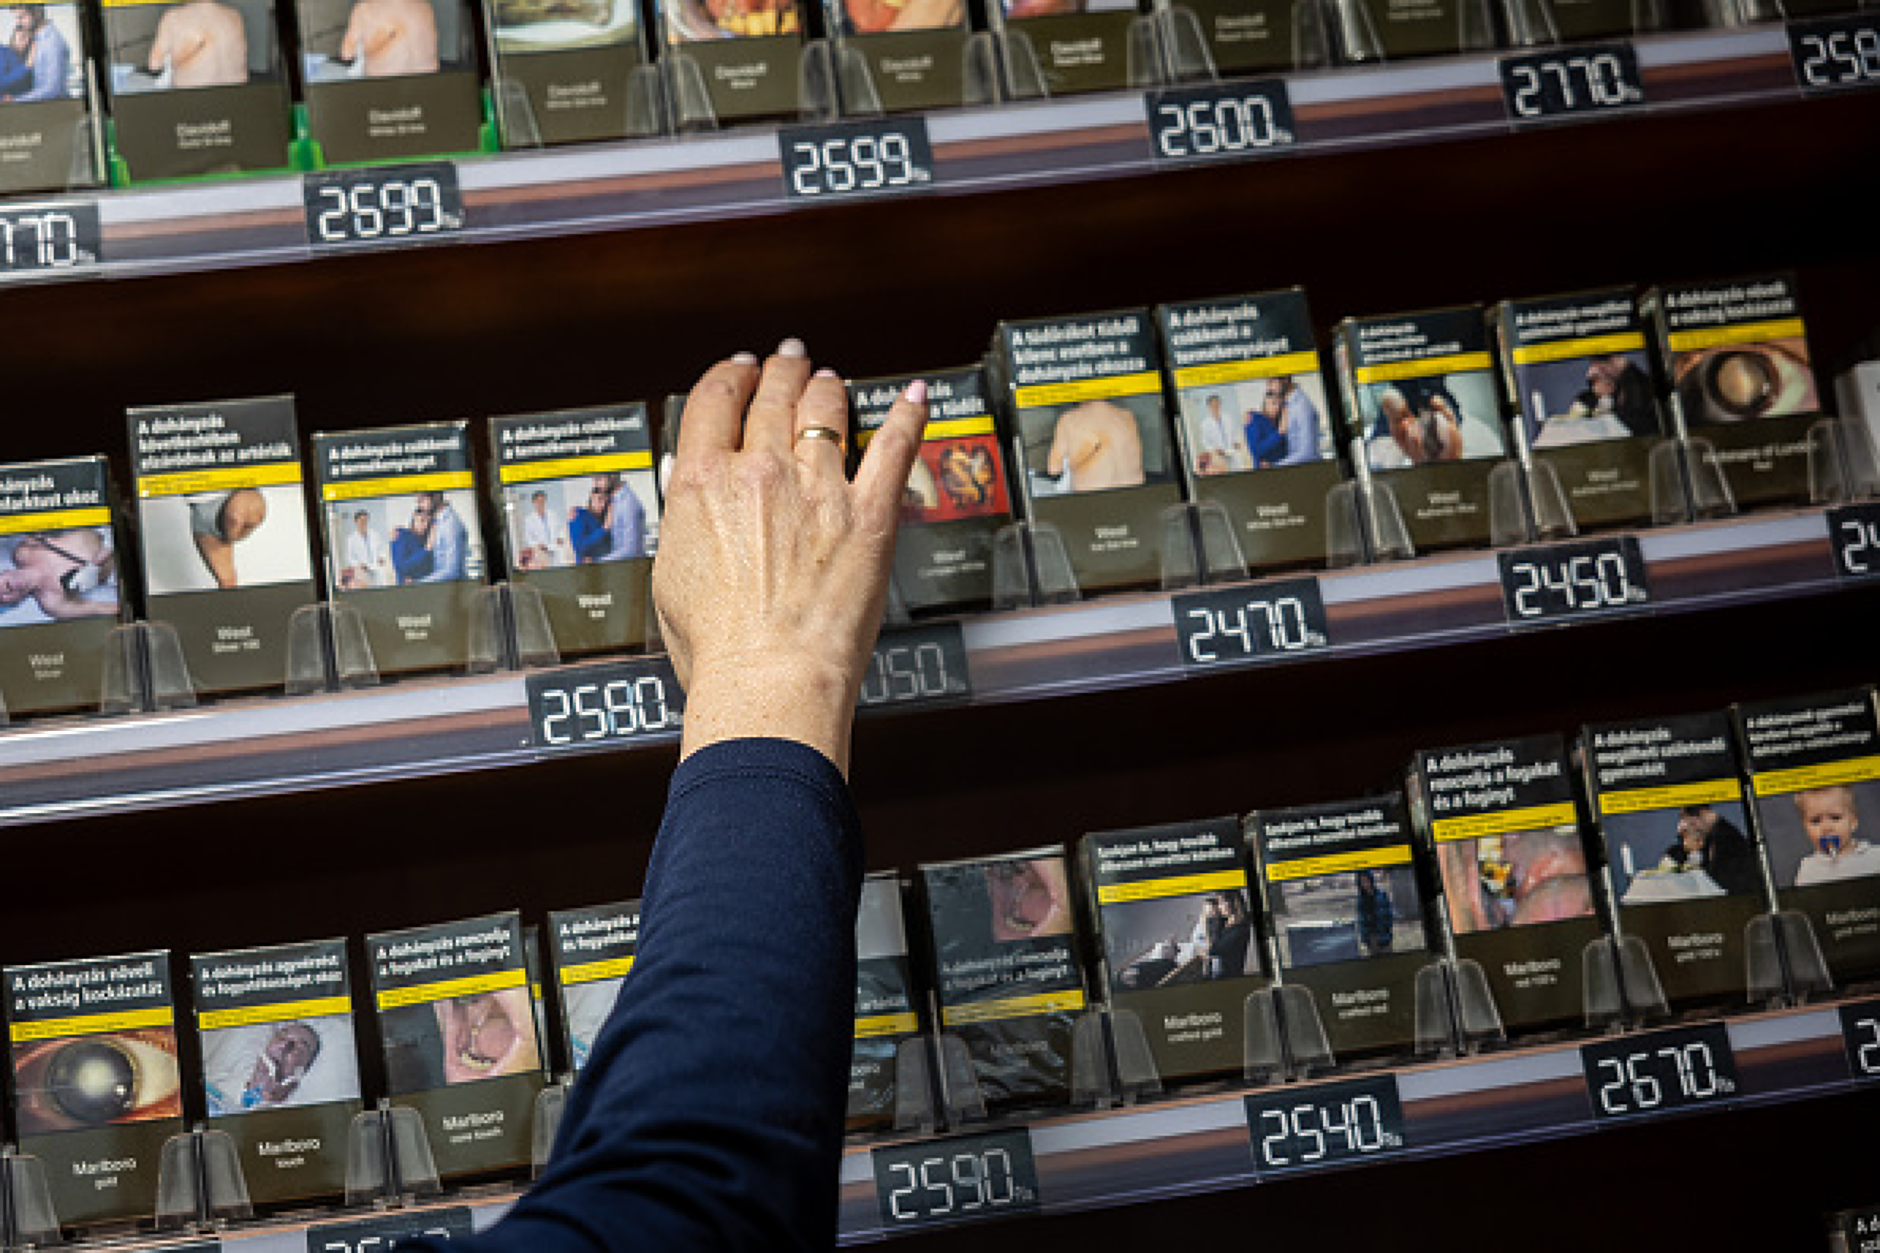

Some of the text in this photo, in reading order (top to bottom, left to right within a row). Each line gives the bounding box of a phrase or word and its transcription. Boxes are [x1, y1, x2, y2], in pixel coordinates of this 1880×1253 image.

[1512, 54, 1626, 116] 2770
[1159, 95, 1277, 156] 2600
[793, 133, 913, 194] 2699
[318, 178, 443, 241] 2699
[1170, 303, 1261, 327] A dohányzás
[1012, 331, 1023, 347] A
[857, 391, 869, 408] A
[139, 413, 225, 434] A dohányzás
[503, 429, 514, 444] A
[515, 423, 580, 443] dohányzás
[329, 447, 340, 462] A
[1512, 553, 1628, 615] 2450
[215, 626, 254, 640] West
[1188, 597, 1307, 661] 2470
[28, 652, 65, 668] West
[860, 642, 947, 702] 050
[1607, 725, 1672, 746] dohányzás
[1427, 746, 1514, 773] A dohányzás
[1430, 770, 1492, 792] roncsolja
[1505, 761, 1560, 783] fogakat
[1433, 794, 1450, 811] és
[560, 922, 571, 937] A
[572, 914, 631, 936] dohányzás
[377, 926, 511, 960] A dohányzás roncsolja
[1667, 932, 1724, 949] Marlboro
[440, 953, 454, 966] és
[1503, 958, 1562, 976] Marlboro
[13, 961, 154, 991] A dohányzás növeli
[201, 967, 211, 980] A
[212, 961, 273, 981] dohányzás
[15, 980, 163, 1011] a vakság kockázatát
[1332, 988, 1390, 1007] Marlboro
[1164, 1011, 1223, 1030] Marlboro
[1598, 1041, 1717, 1114] 2670
[442, 1110, 504, 1130] Marlboro
[1260, 1094, 1382, 1165] 2540
[259, 1137, 321, 1156] Marlboro
[72, 1157, 138, 1176] Marlboro
[888, 1148, 1015, 1219] 2590
